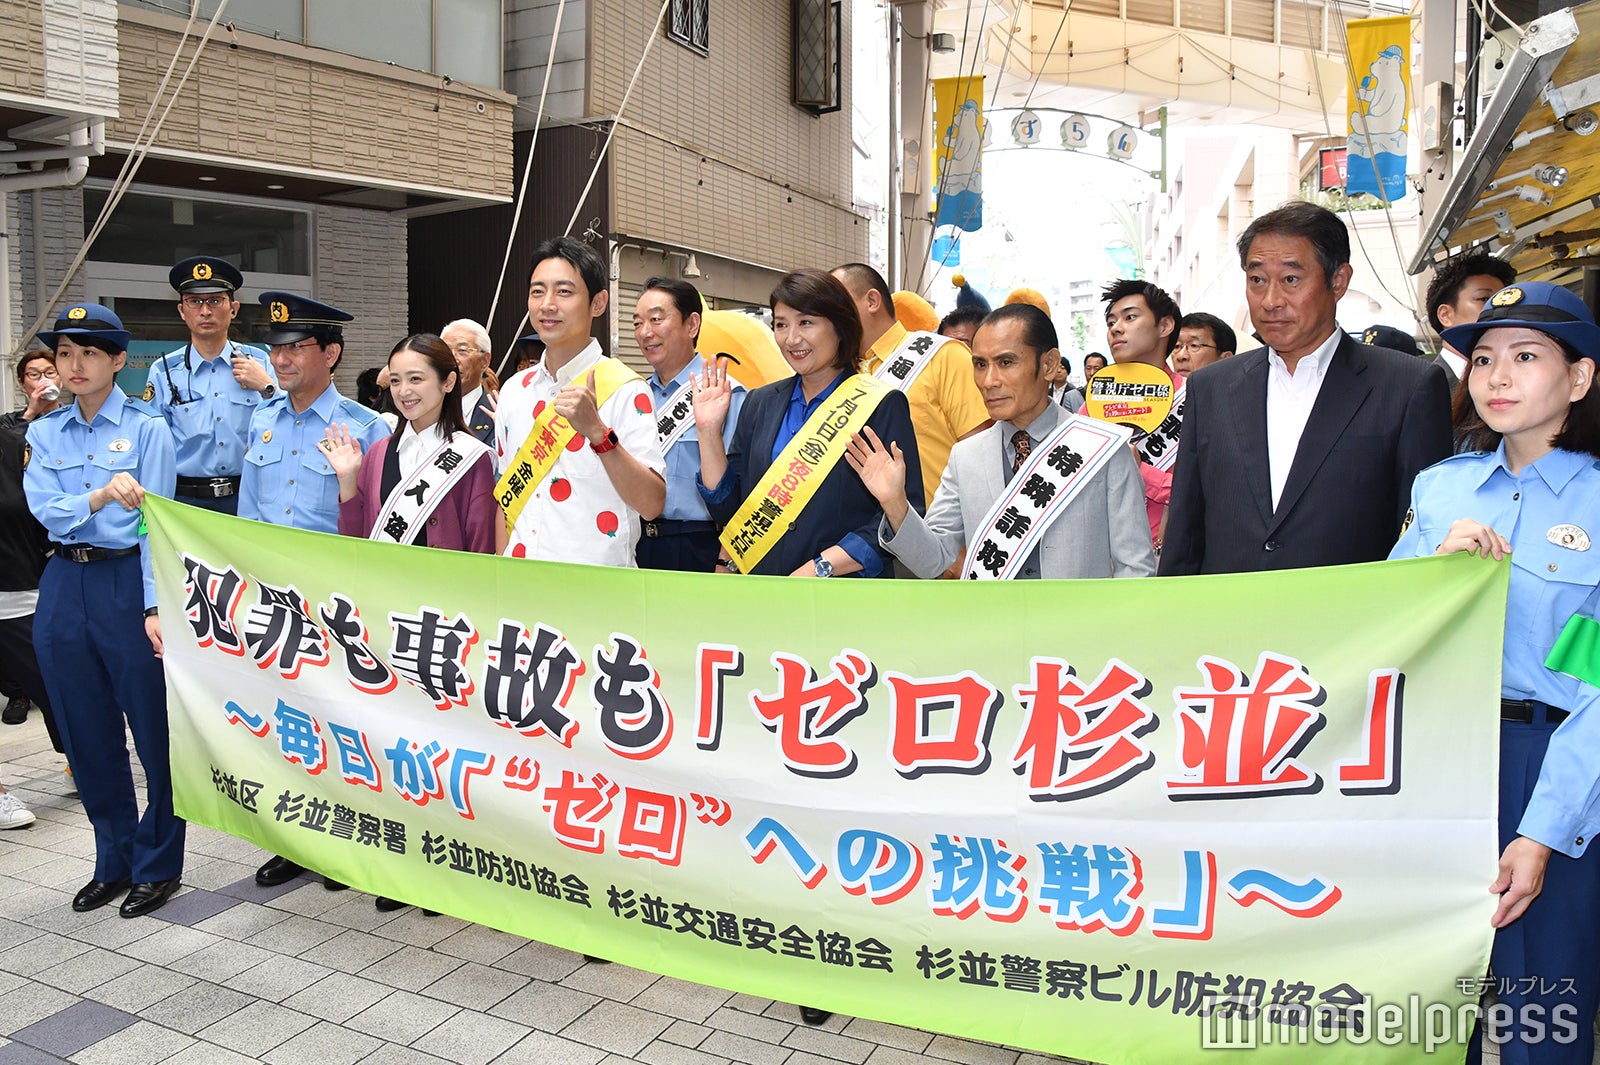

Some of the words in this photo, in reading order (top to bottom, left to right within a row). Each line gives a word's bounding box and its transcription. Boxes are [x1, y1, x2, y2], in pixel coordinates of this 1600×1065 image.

[887, 335, 934, 381] 交通
[1092, 382, 1170, 398] 警視庁ゼロ係
[210, 763, 265, 814] 杉並区
[273, 789, 408, 855] 杉並警察署
[421, 830, 593, 909] 杉並防犯協会
[606, 884, 895, 973] 杉並交通安全協会
[915, 944, 1365, 1033] 杉並警察ビル防犯協会
